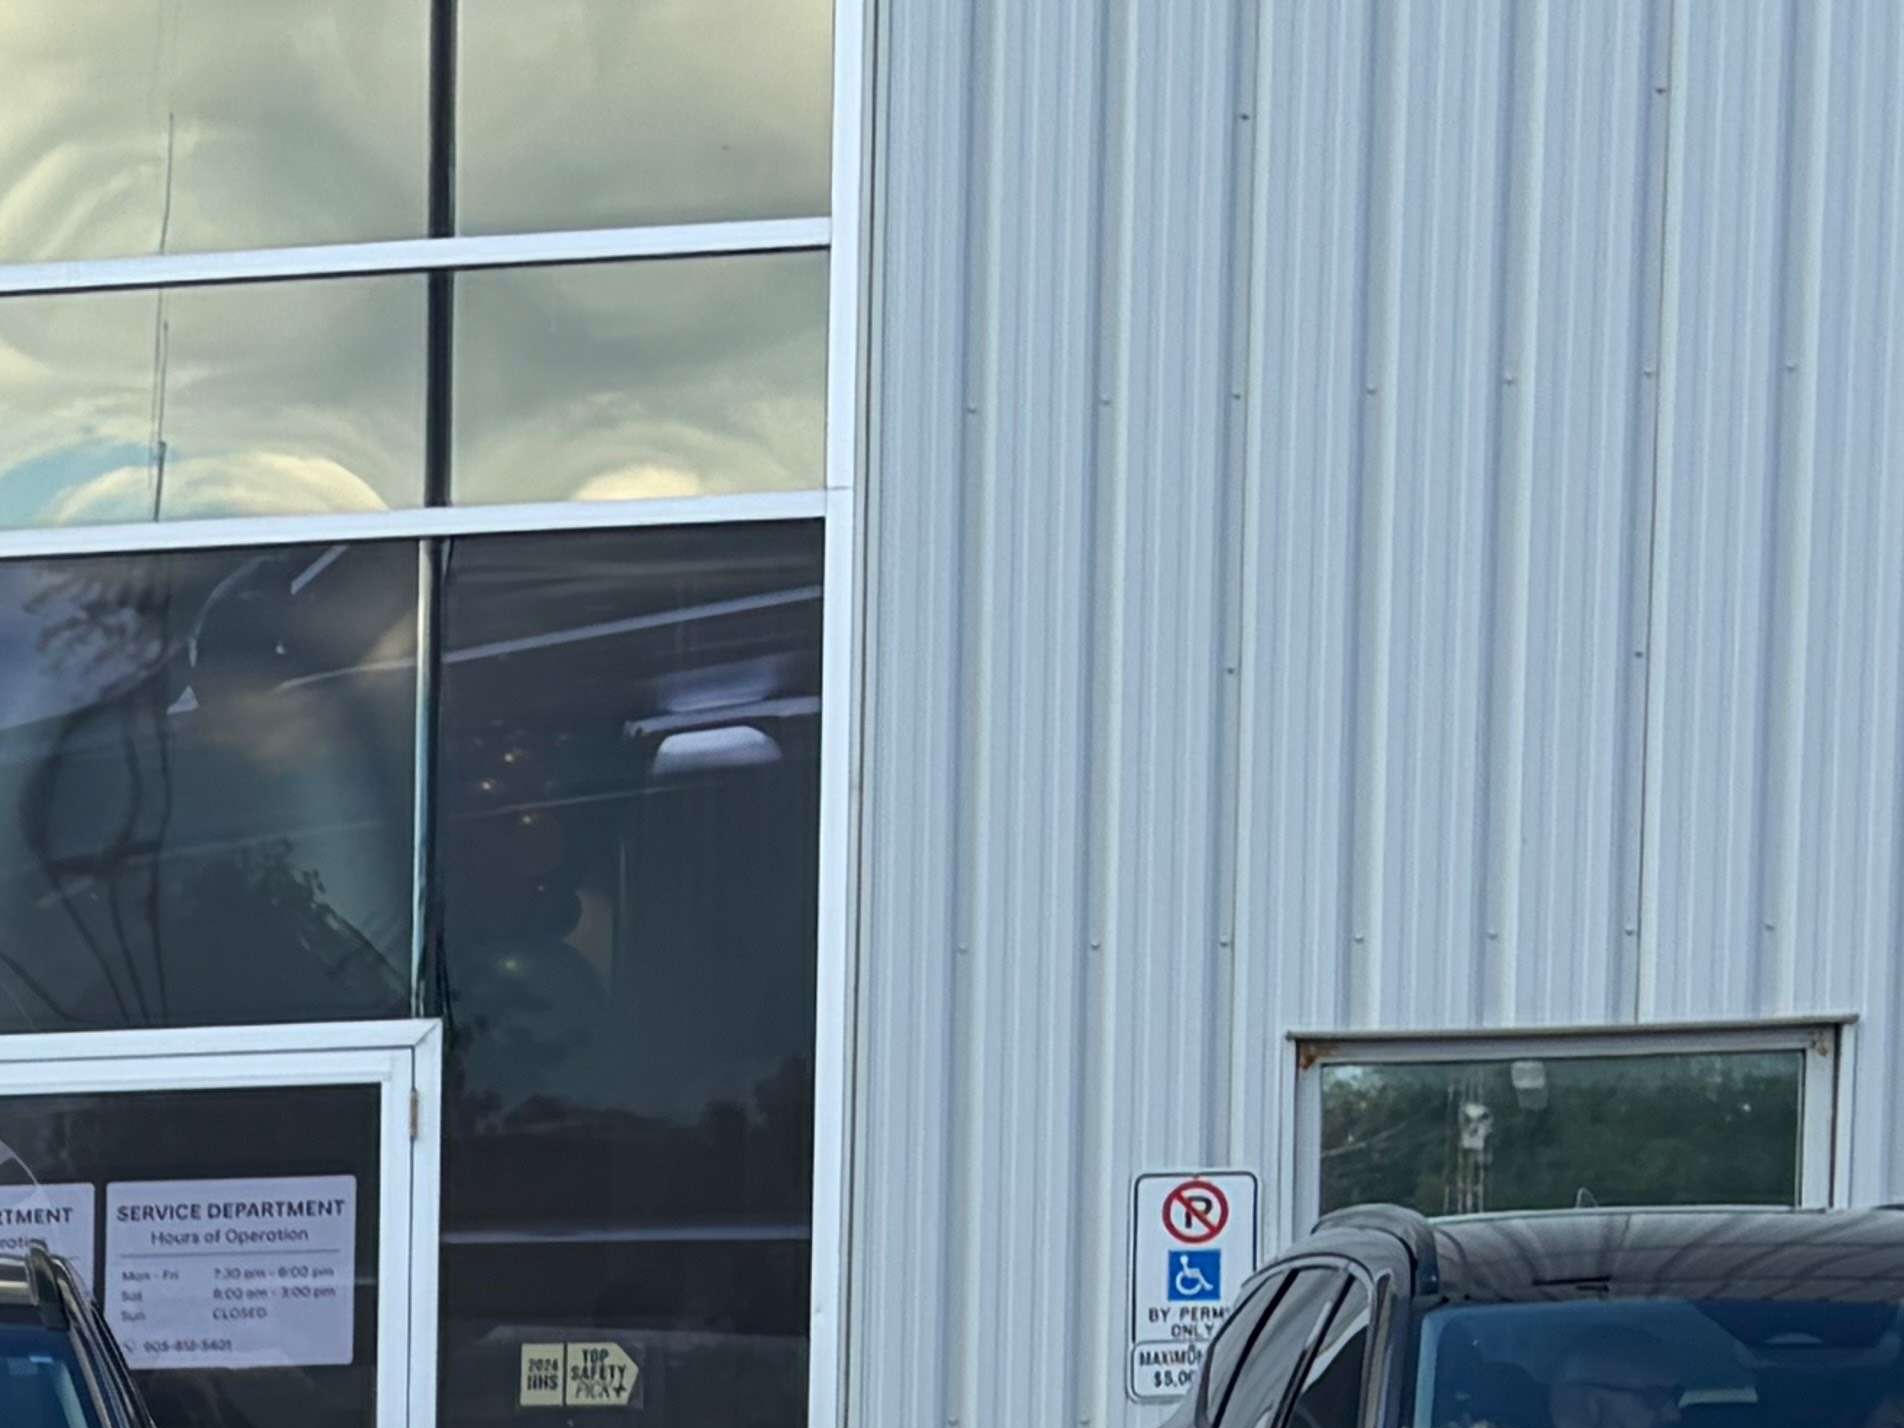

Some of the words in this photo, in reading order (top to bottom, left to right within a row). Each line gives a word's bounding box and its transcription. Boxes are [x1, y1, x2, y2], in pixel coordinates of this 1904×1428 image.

[116, 1203, 202, 1222] SERVICE
[207, 1199, 346, 1220] DEPARTMENT
[150, 1230, 200, 1247] Hours
[204, 1228, 220, 1244] of
[224, 1226, 309, 1247] Operation
[1148, 1307, 1170, 1323] BY
[1179, 1306, 1230, 1321] PERM
[1170, 1323, 1214, 1338] ONLY
[581, 1348, 609, 1364] TOP
[570, 1364, 626, 1381] SAFETY
